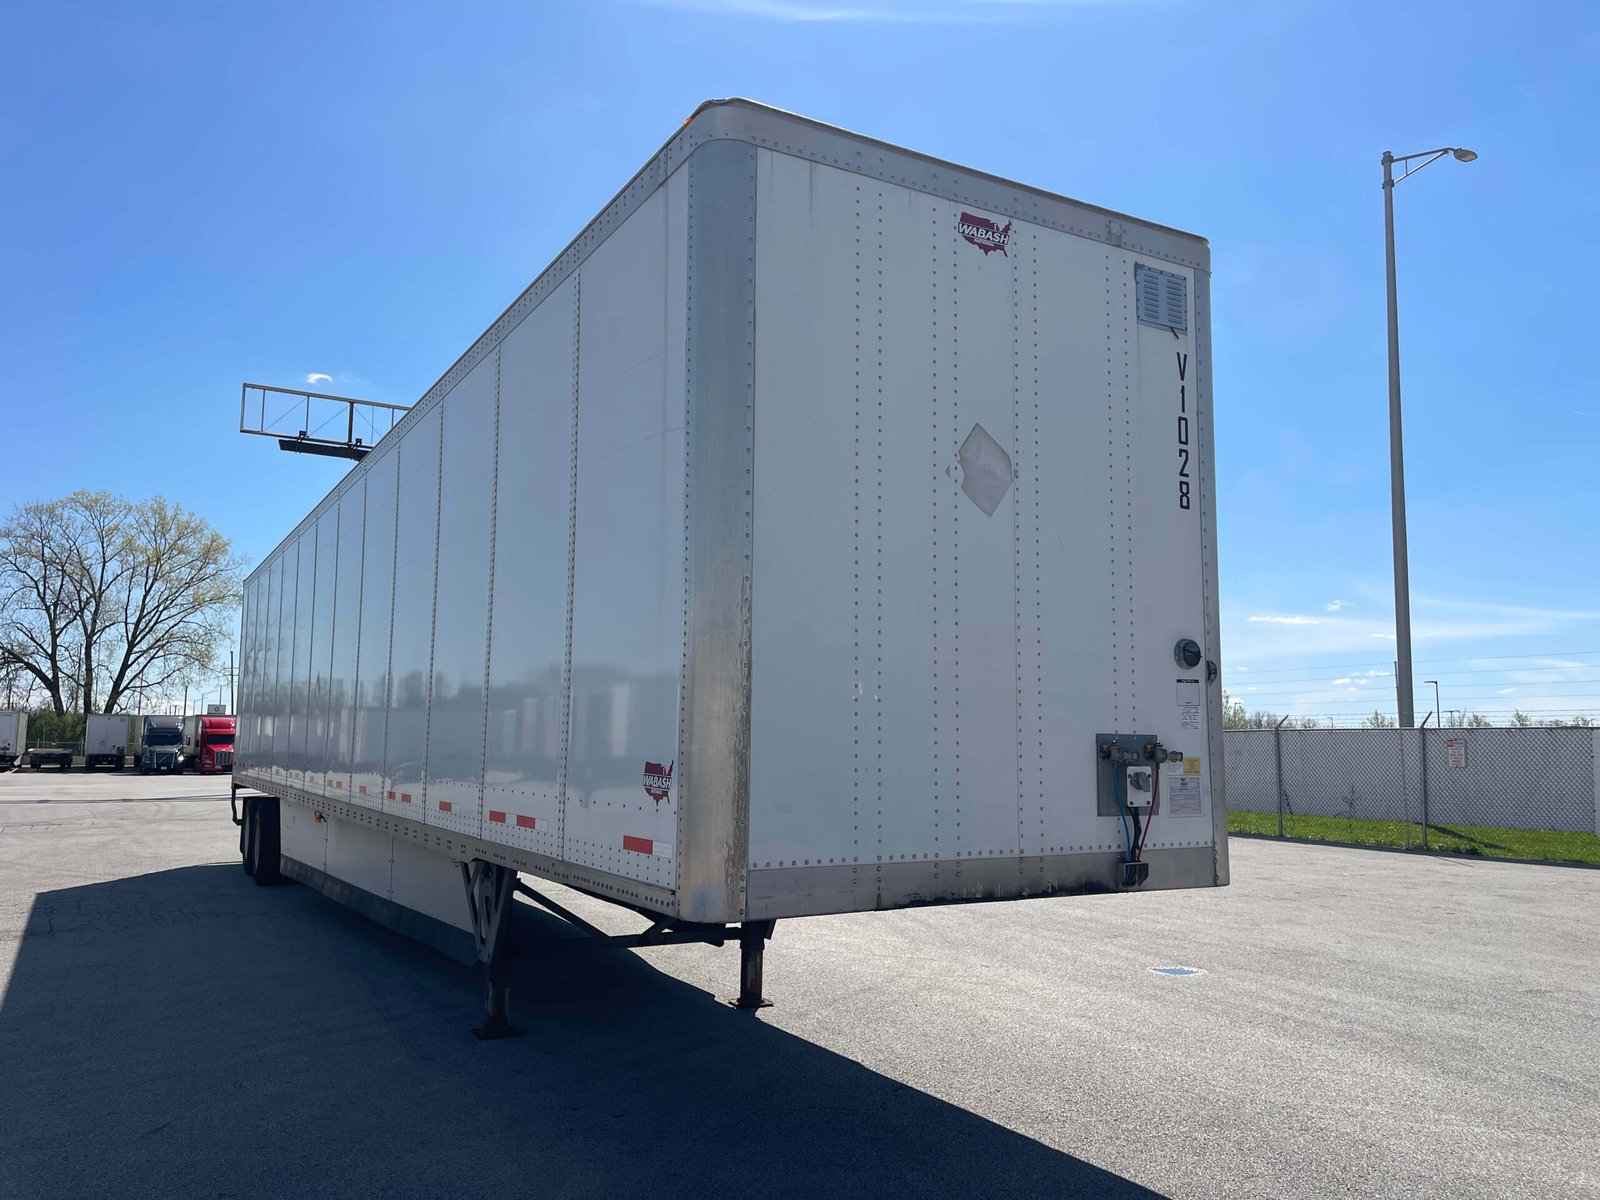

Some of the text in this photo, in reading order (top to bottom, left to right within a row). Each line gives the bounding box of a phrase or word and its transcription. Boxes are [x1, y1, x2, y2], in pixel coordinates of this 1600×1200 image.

[959, 223, 1009, 245] WABASH
[1176, 352, 1190, 510] V1028
[643, 775, 672, 790] WABASH
